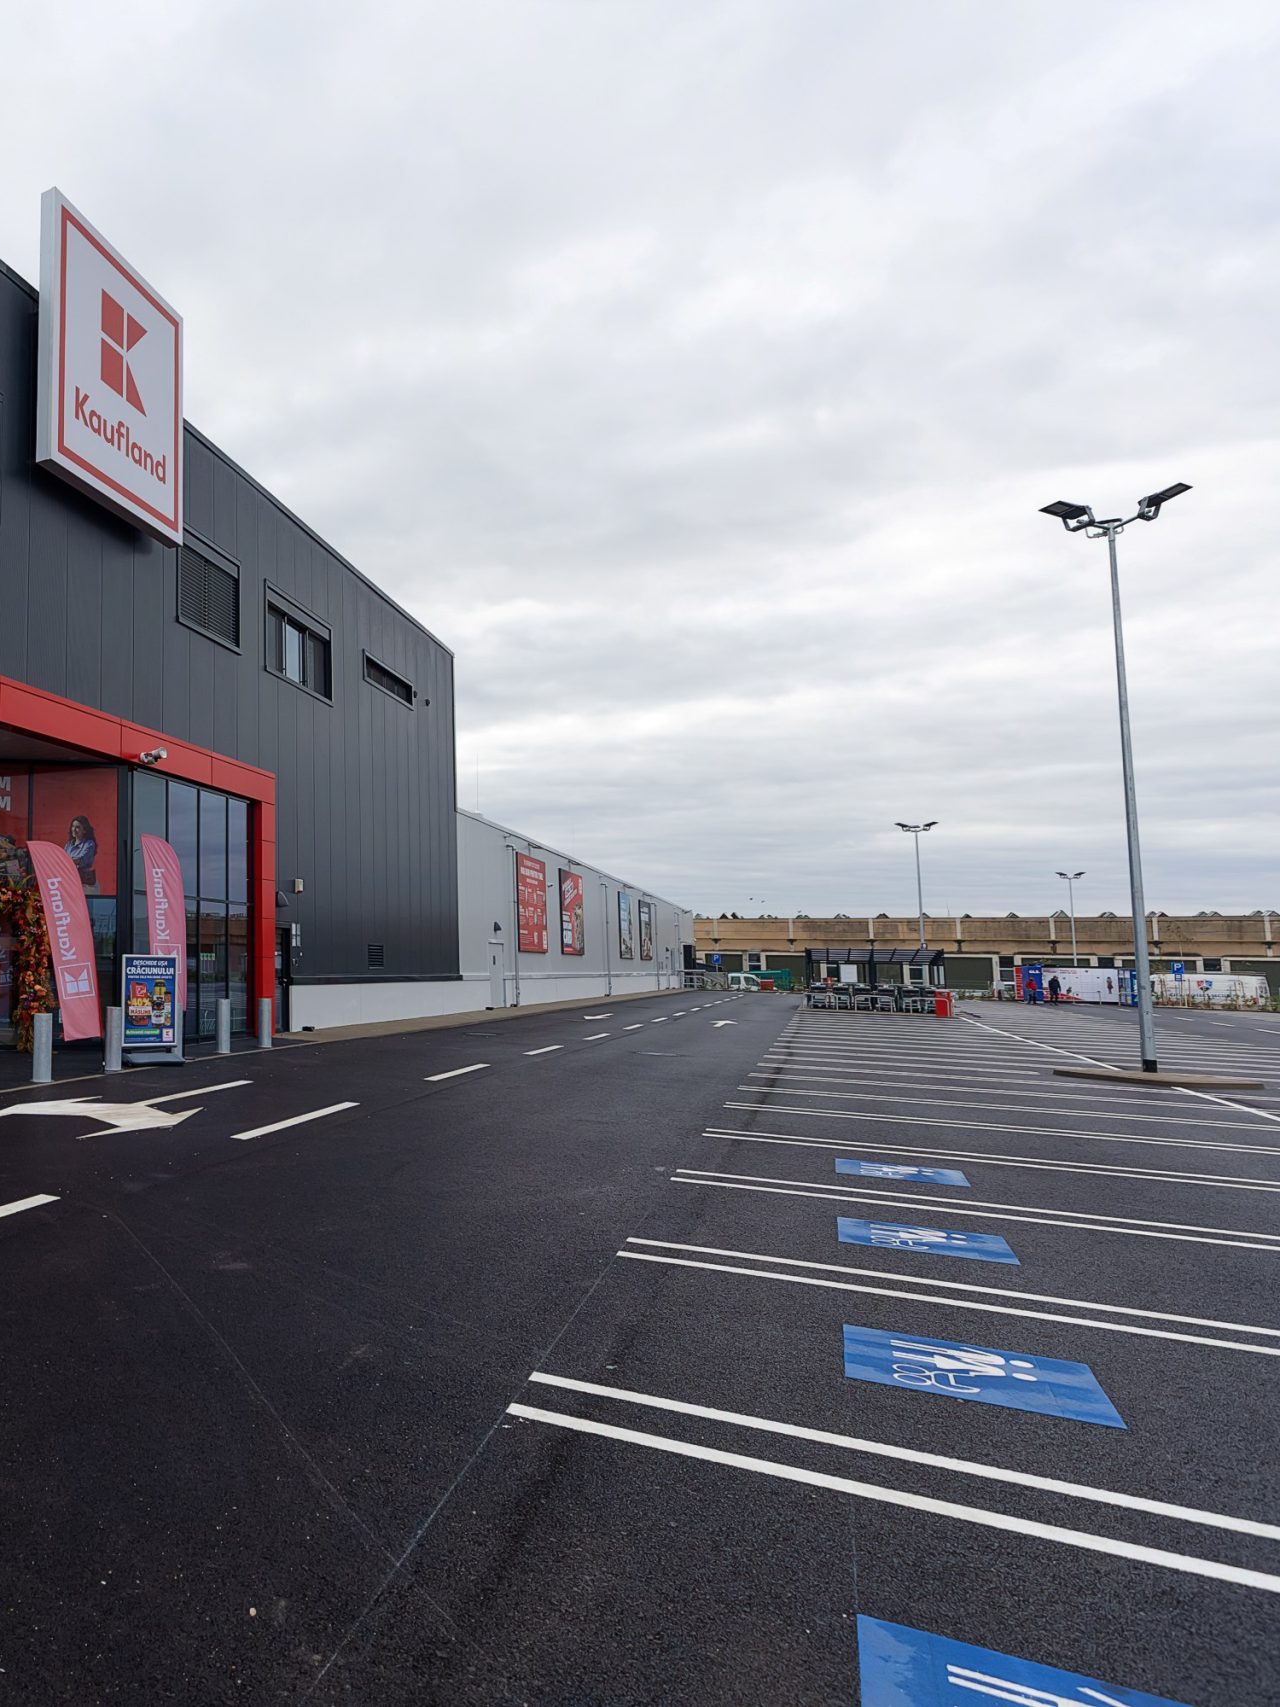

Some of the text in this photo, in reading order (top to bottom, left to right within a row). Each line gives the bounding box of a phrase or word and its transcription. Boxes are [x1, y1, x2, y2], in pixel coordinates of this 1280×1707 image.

[74, 385, 167, 485] Kaufland
[126, 966, 174, 975] CRĂCIUNULUI
[1173, 963, 1182, 971] P
